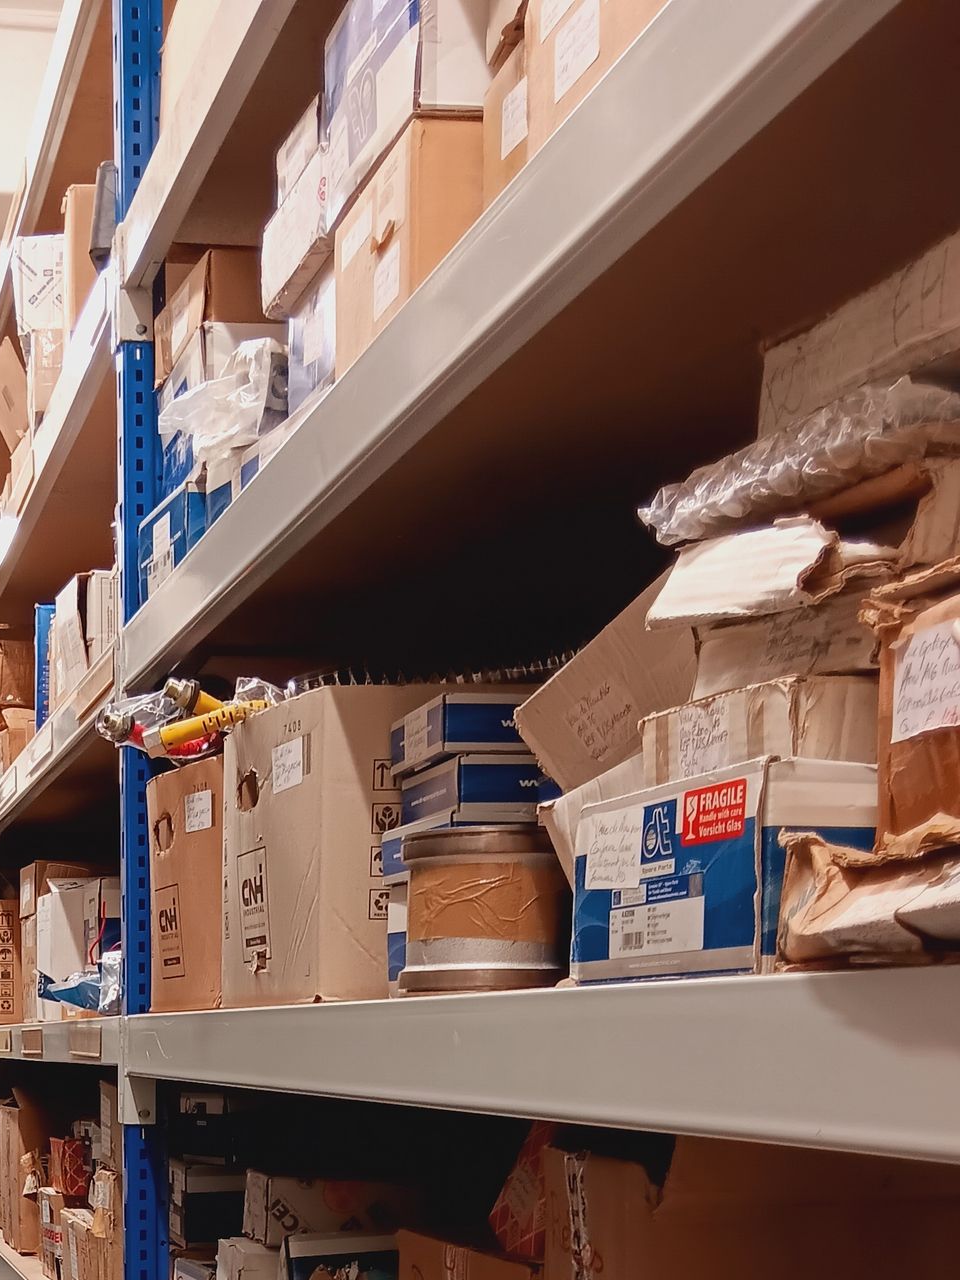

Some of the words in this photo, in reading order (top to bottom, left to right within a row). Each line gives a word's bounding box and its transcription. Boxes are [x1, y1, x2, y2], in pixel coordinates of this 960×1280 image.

[700, 785, 744, 812] FRAGILE
[699, 813, 717, 823] Handle
[717, 810, 730, 820] with
[730, 808, 743, 817] care
[698, 823, 726, 838] Vorsicht
[726, 820, 742, 832] Glas
